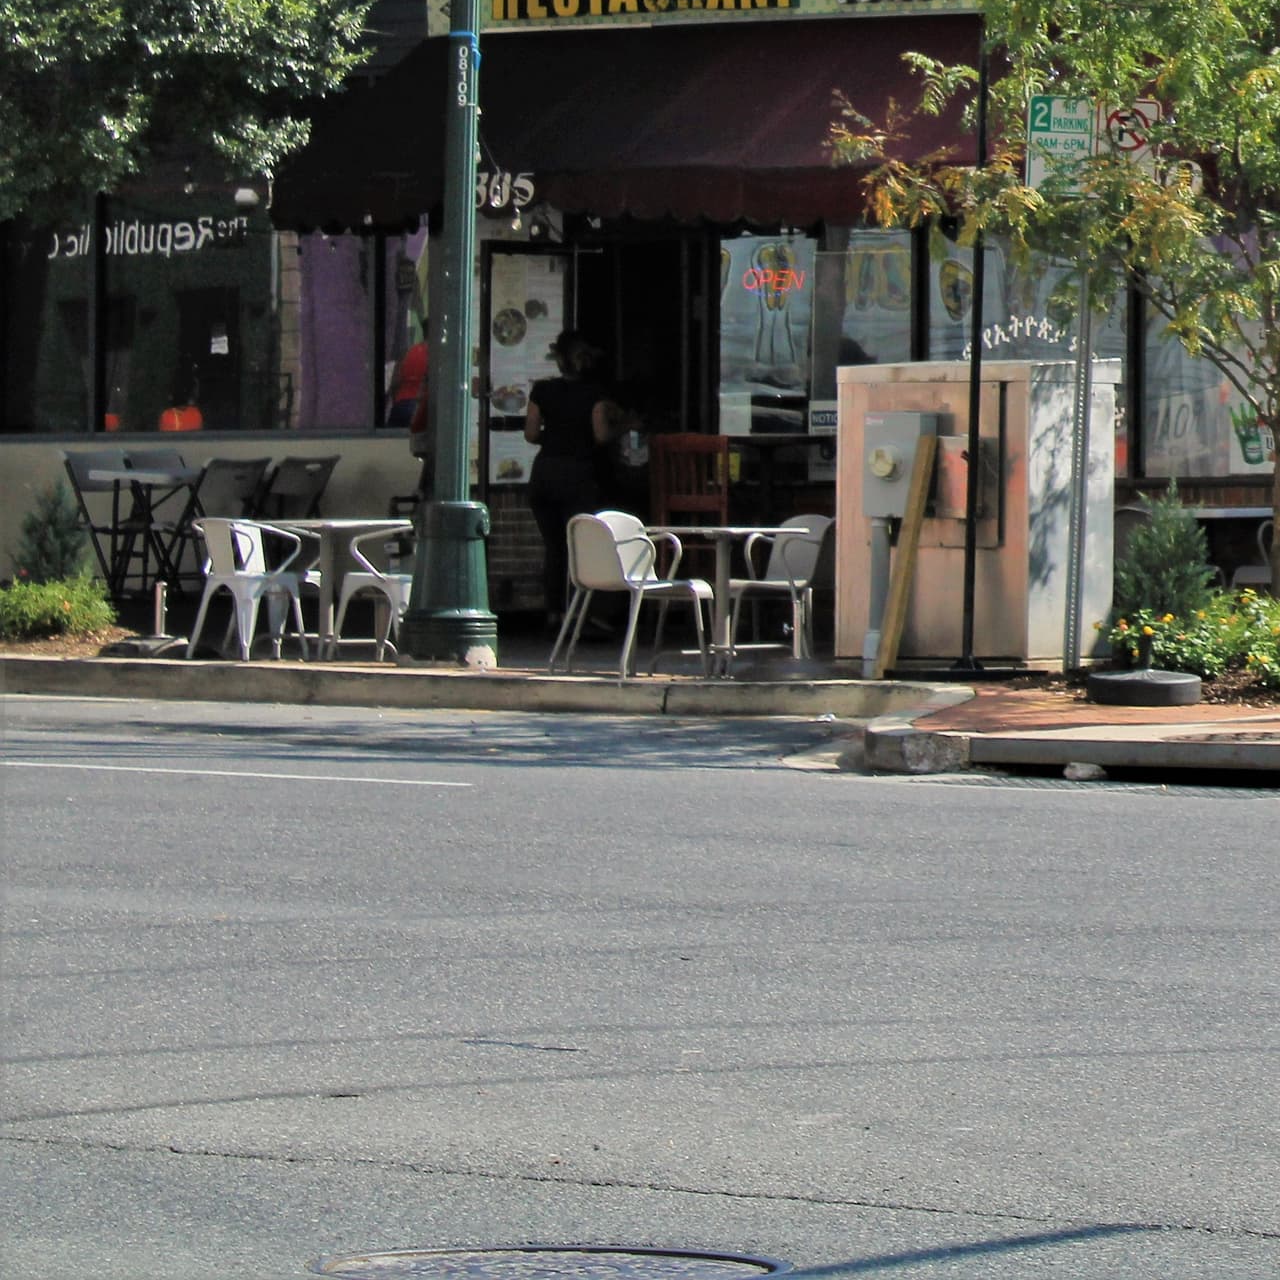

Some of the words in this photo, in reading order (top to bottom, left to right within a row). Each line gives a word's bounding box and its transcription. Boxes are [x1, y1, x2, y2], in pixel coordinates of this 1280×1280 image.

[458, 46, 468, 107] 08109
[1034, 102, 1049, 128] 2
[1052, 117, 1088, 132] PARKING
[742, 269, 806, 291] OPEN
[812, 414, 838, 423] NOTIC
